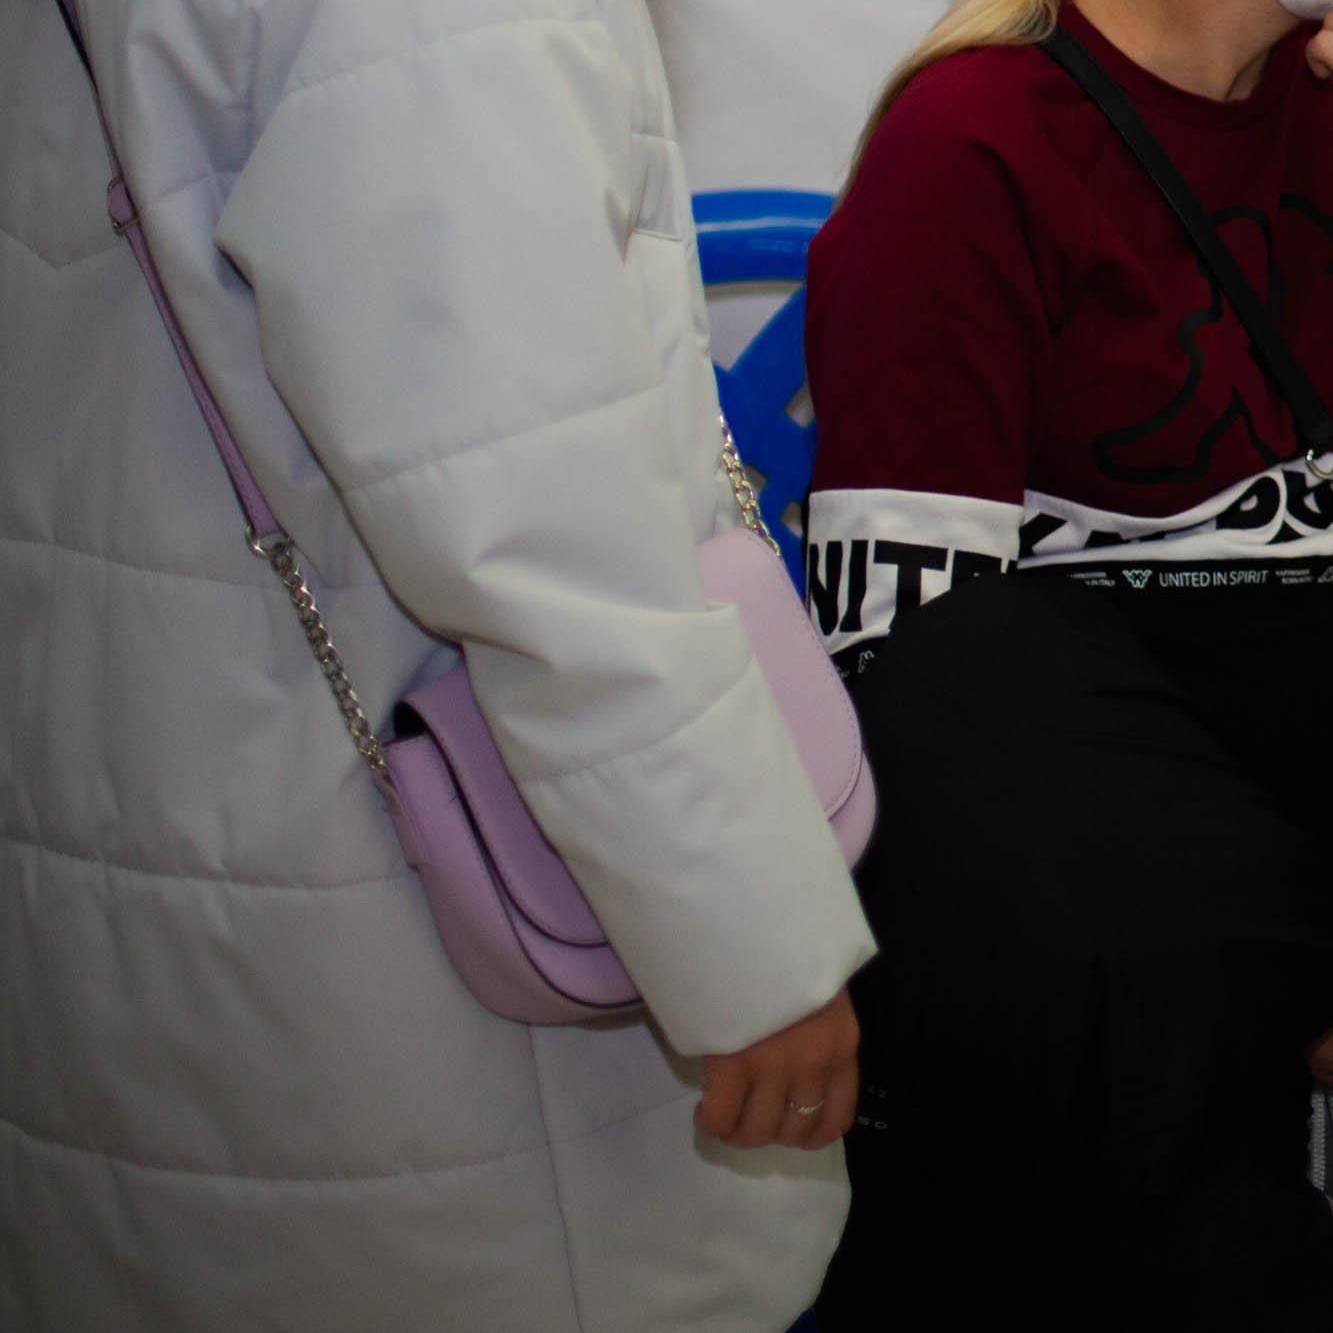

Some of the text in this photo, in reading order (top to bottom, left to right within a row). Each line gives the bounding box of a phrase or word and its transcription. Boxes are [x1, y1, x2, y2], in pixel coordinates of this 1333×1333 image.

[1159, 570, 1210, 587] UNITED
[1213, 570, 1227, 586] IN
[1229, 569, 1269, 586] SPIRIT
